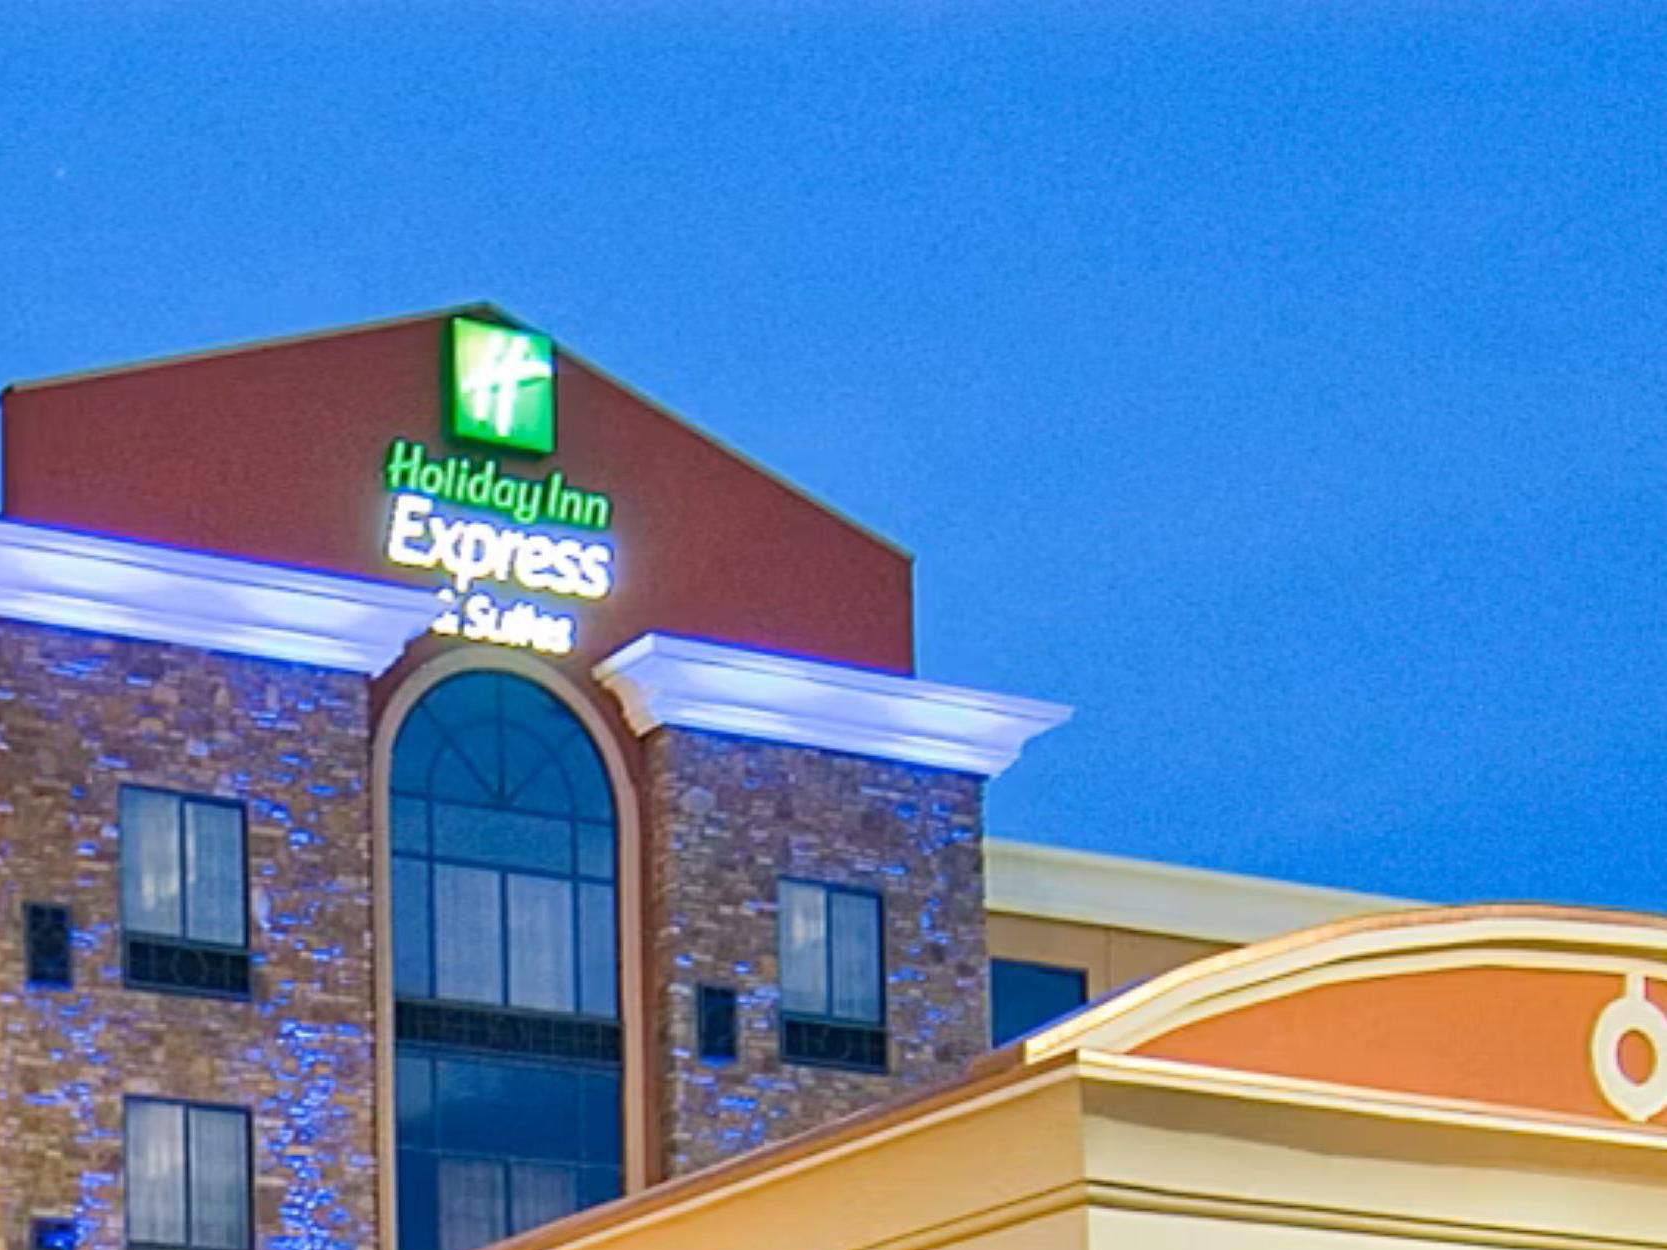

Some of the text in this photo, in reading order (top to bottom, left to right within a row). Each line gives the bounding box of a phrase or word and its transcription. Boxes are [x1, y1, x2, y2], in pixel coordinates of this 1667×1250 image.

[387, 440, 610, 529] Holiday Inn
[387, 493, 613, 599] Express
